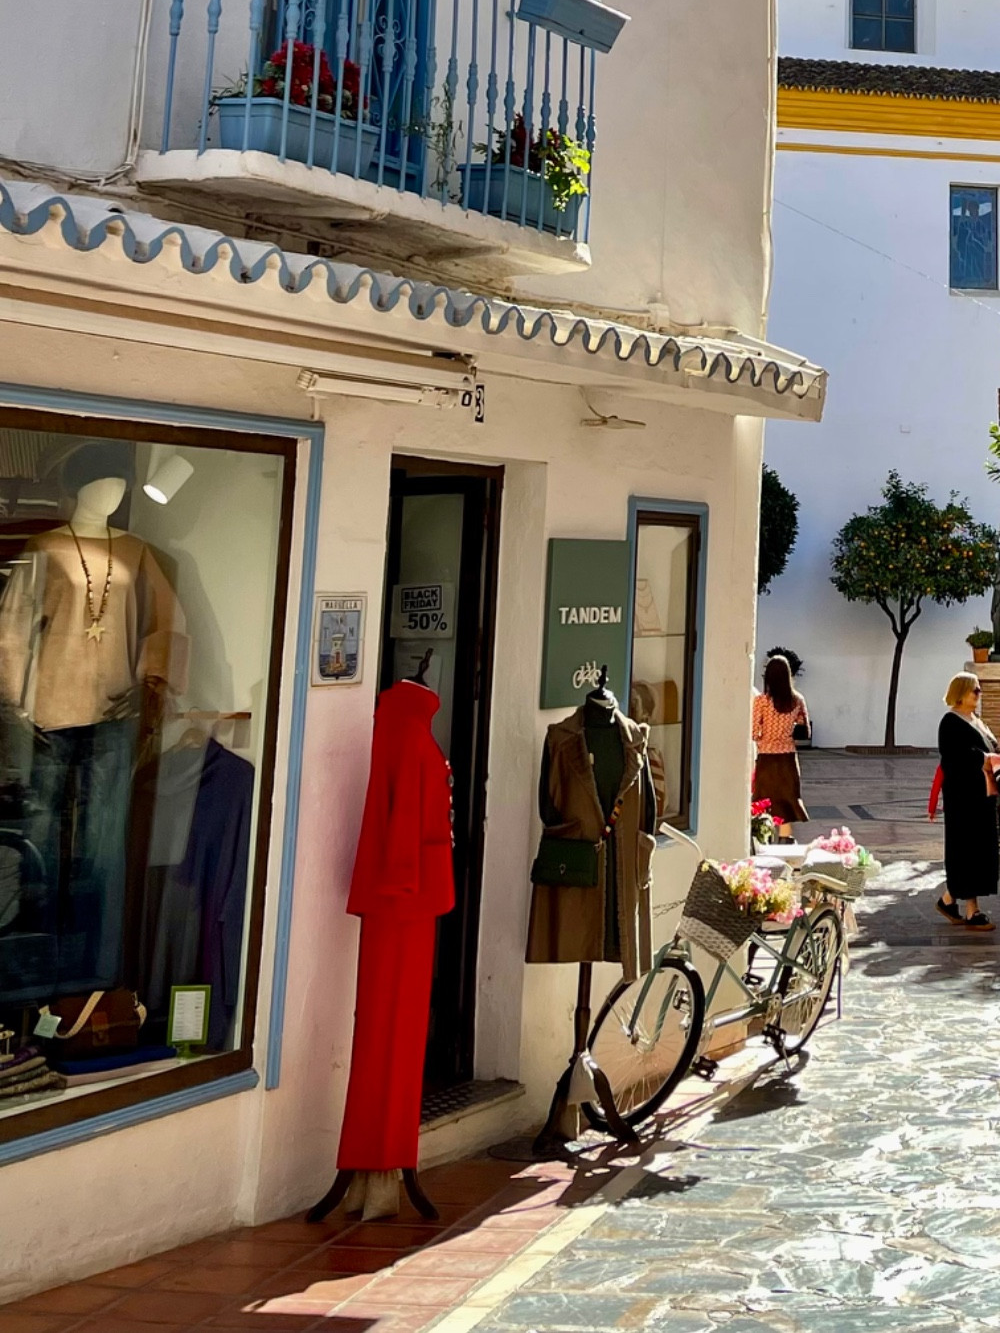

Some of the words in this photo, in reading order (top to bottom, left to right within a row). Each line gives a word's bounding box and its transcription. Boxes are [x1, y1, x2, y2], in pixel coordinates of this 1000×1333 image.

[404, 588, 438, 599] BLACK
[404, 599, 438, 609] FRIDAY
[402, 612, 448, 632] -50%
[558, 606, 623, 625] TANDEM
